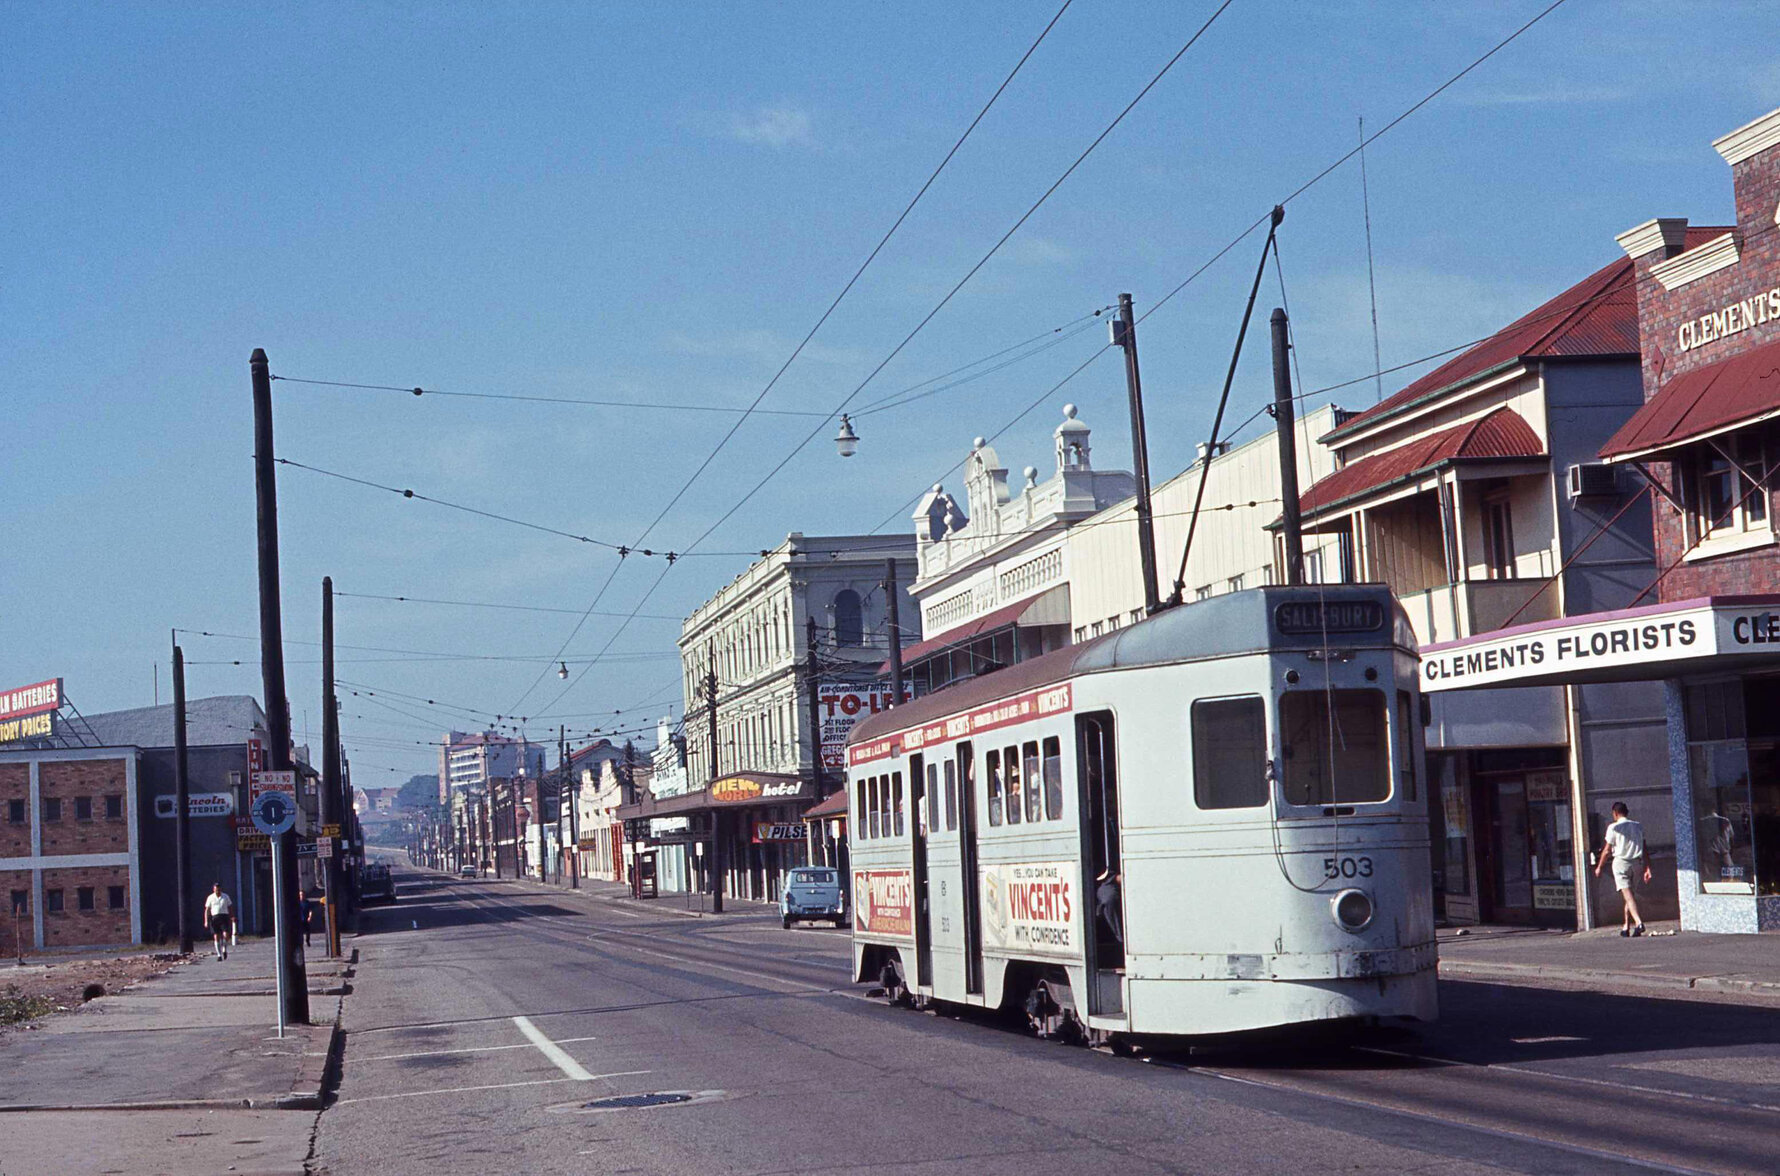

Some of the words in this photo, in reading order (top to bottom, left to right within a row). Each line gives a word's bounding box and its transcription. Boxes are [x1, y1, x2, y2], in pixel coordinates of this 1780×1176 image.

[1678, 287, 1780, 352] CLEMENTS
[1282, 605, 1373, 627] SALISBURY
[1426, 642, 1544, 680] CLEMENTS
[1557, 620, 1696, 660] FLORISTS
[12, 683, 57, 711] BATTERIES
[21, 713, 52, 738] PRICES
[187, 795, 226, 805] incoln
[762, 781, 802, 797] hotel
[771, 825, 812, 839] PILSE
[1045, 867, 1058, 878] TAKE
[1323, 856, 1374, 879] 503
[1008, 876, 1071, 923] VINCENT'S
[1014, 925, 1029, 942] WITH
[1031, 925, 1070, 947] CONFIDENCE
